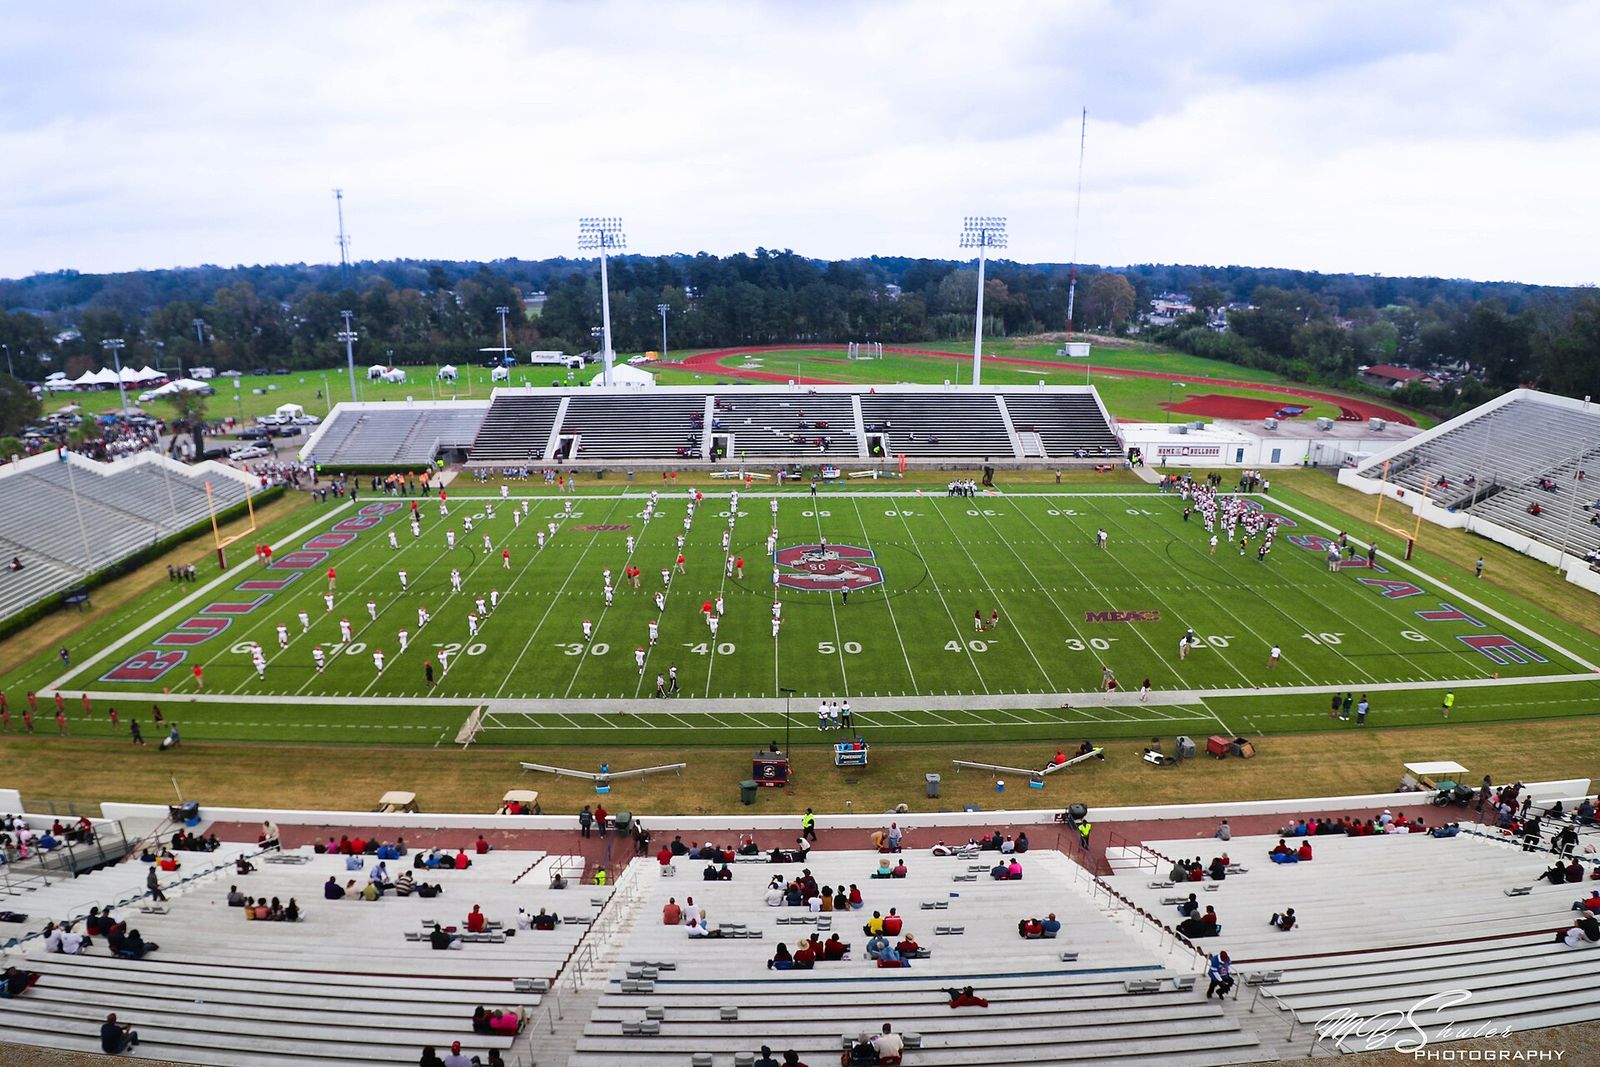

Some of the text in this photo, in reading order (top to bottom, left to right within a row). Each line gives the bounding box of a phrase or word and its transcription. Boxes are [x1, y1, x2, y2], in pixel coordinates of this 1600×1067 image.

[809, 563, 826, 571] SC
[98, 501, 404, 683] BULLDOGS
[1085, 611, 1161, 622] MEAC
[1189, 635, 1229, 648] 20
[1301, 632, 1343, 645] 10
[1400, 630, 1429, 642] G
[328, 642, 367, 655] 10
[443, 642, 487, 656] 20
[564, 643, 609, 656] 30
[690, 642, 736, 656] 40
[817, 641, 862, 654] 50
[944, 640, 988, 652] 40
[1064, 638, 1110, 650] 30
